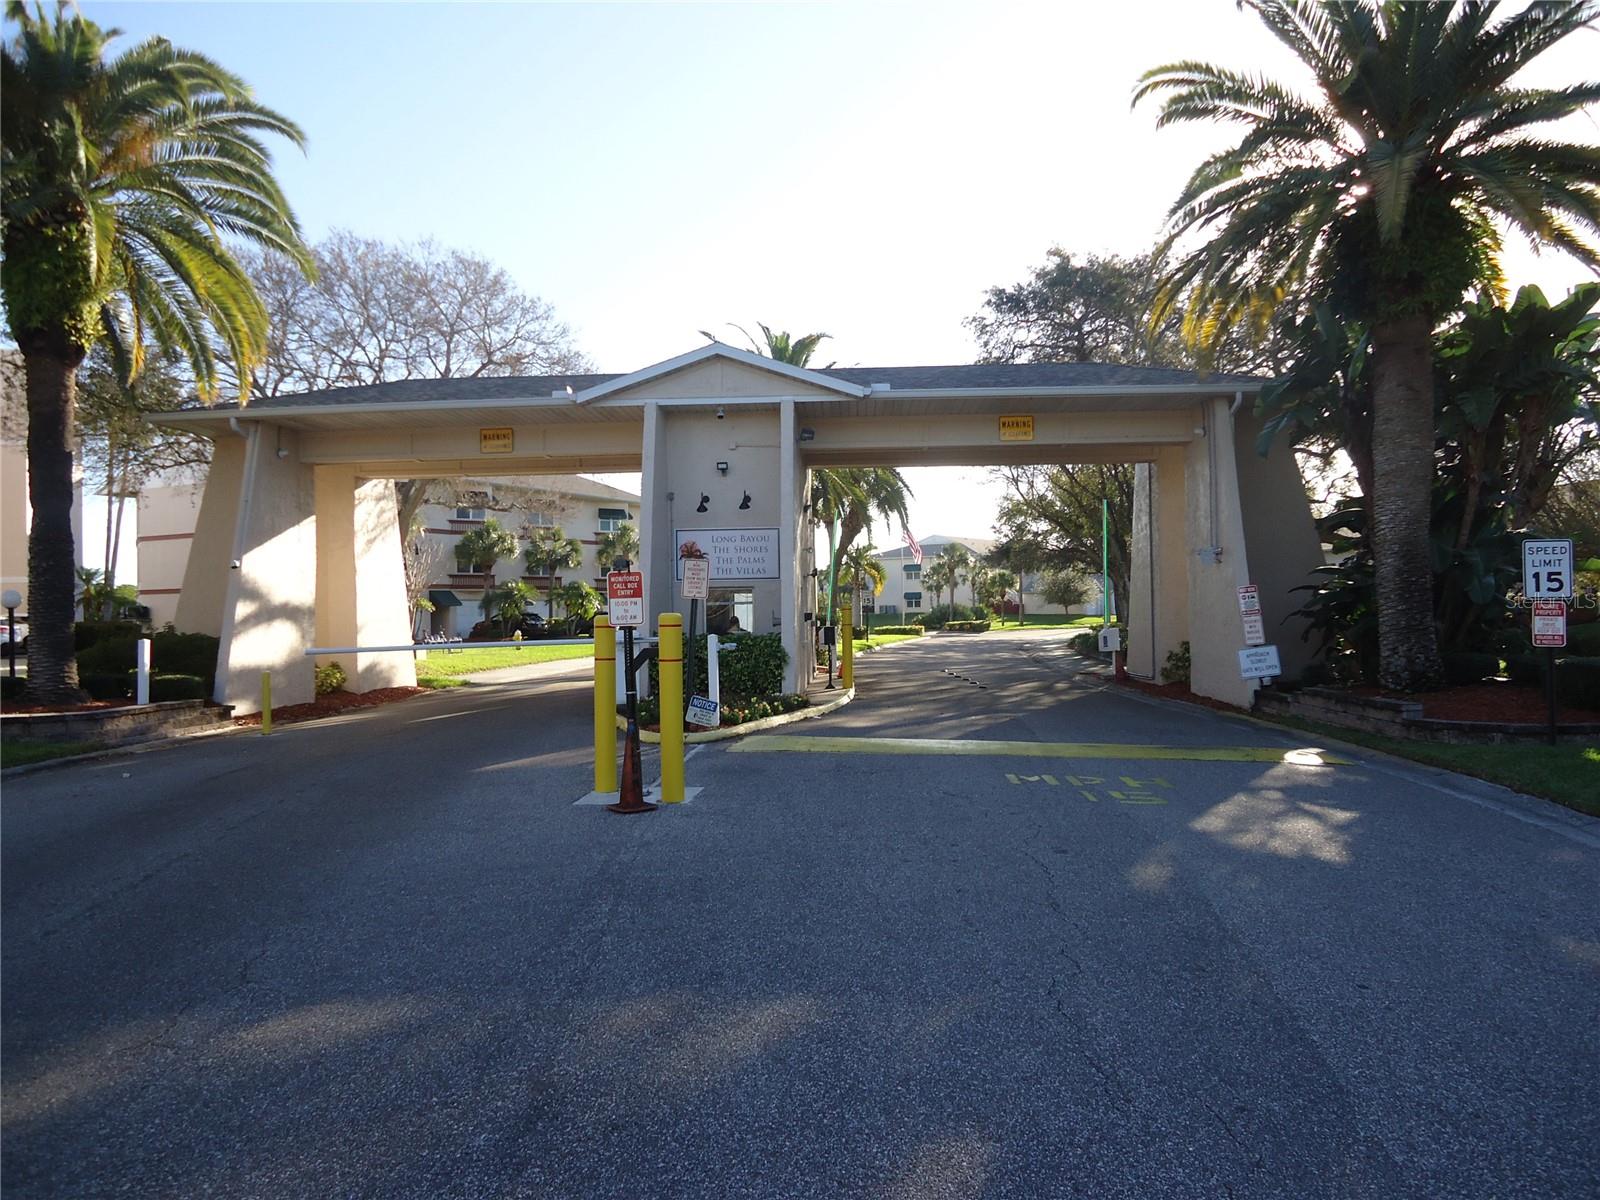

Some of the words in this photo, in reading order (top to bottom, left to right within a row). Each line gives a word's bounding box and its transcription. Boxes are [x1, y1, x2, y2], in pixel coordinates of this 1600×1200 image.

[1001, 420, 1031, 428] WARNING
[482, 432, 511, 440] WARNING
[711, 535, 737, 543] LONG
[740, 535, 770, 543] BAYOU
[712, 545, 730, 554] THE
[734, 545, 769, 553] SHORES
[1527, 546, 1568, 555] SPEED
[716, 556, 733, 565] THE
[737, 556, 766, 564] PALMS
[1532, 558, 1563, 568] LIMIT
[716, 567, 733, 575] THE
[736, 566, 767, 575] VILLAS
[1532, 571, 1565, 593] 15
[692, 698, 716, 711] NOTICE
[1080, 790, 1169, 805] 15
